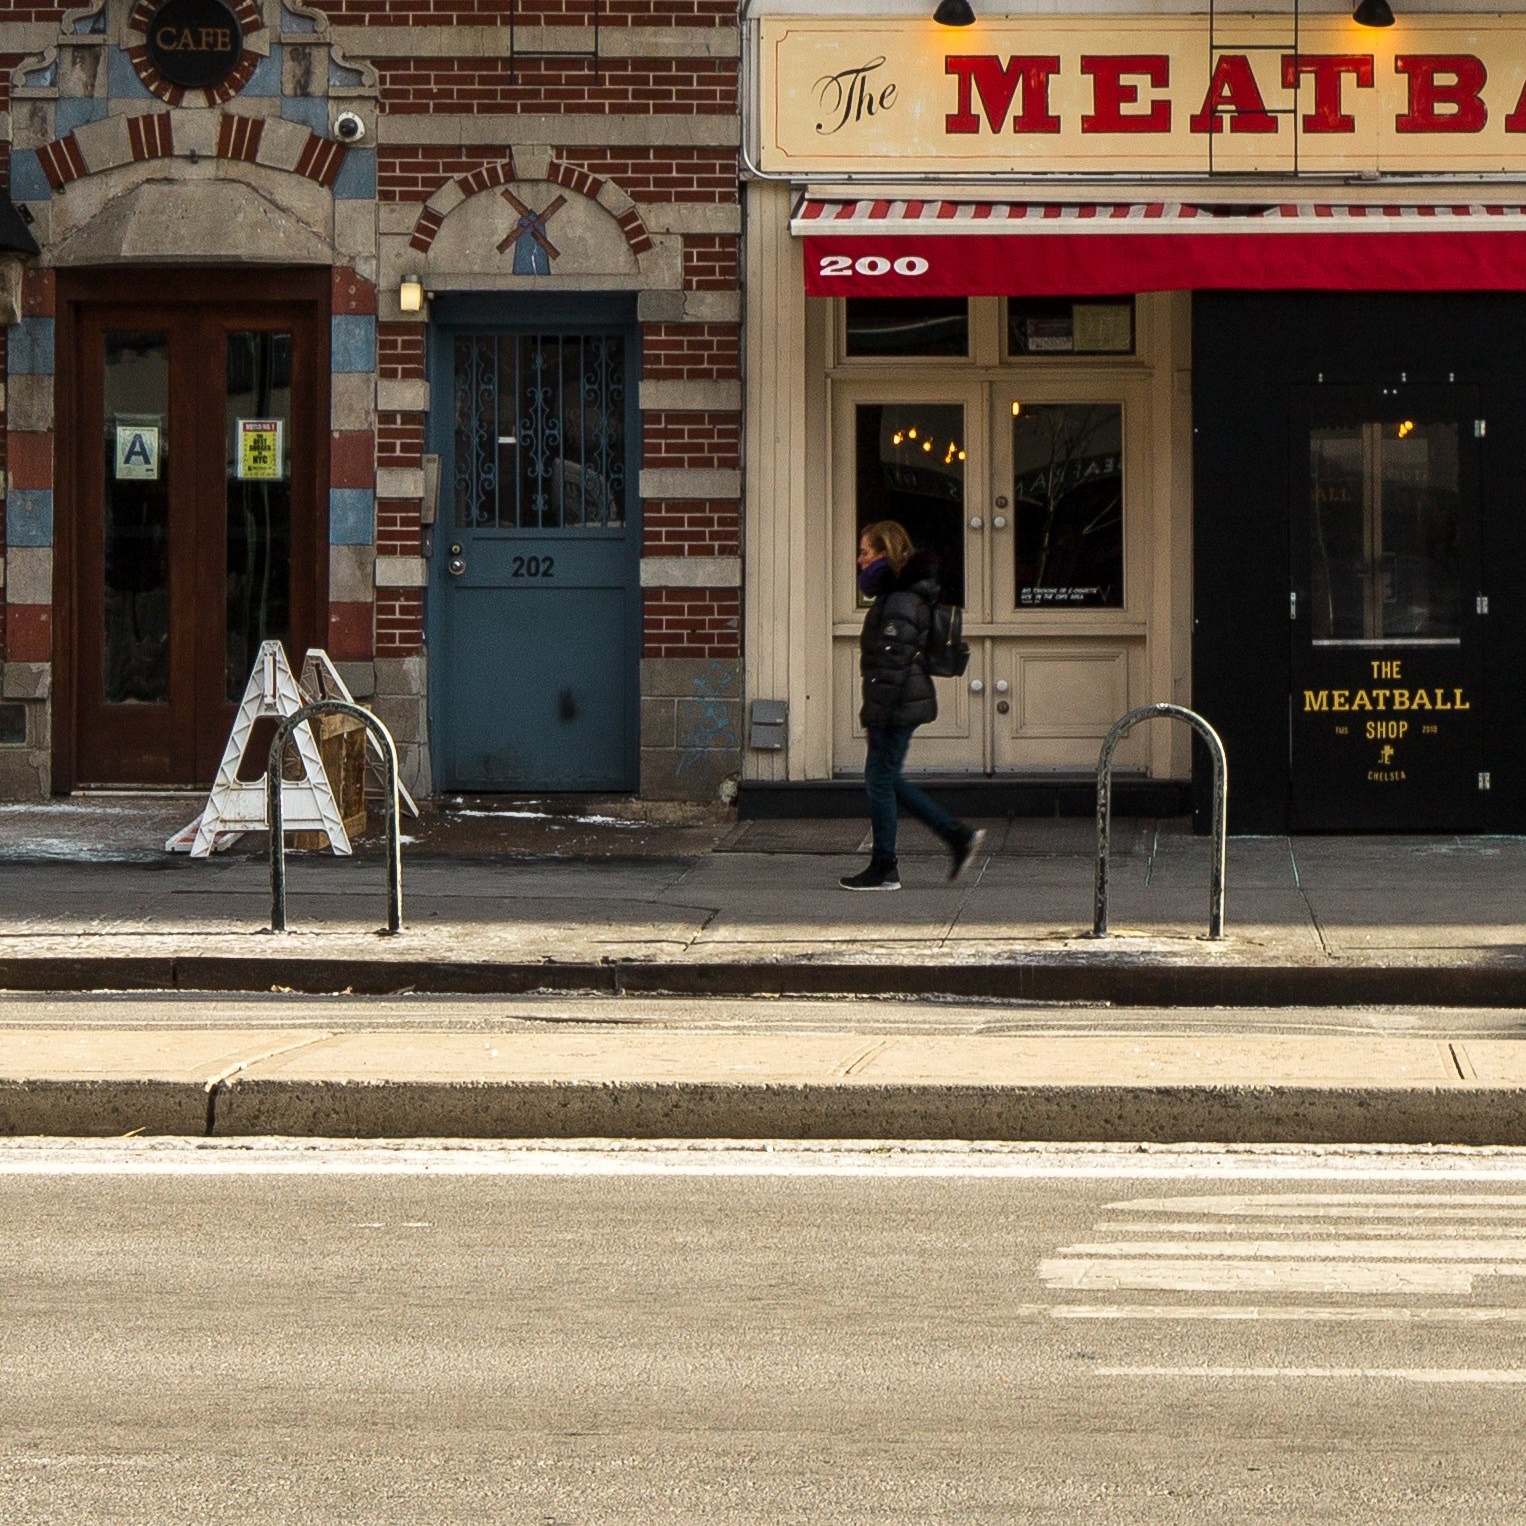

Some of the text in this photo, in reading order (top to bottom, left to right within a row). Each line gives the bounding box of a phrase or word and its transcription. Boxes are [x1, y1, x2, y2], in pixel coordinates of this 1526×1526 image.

[156, 27, 231, 53] CAFE
[811, 55, 898, 136] The
[819, 256, 929, 277] 200
[123, 433, 152, 465] A
[511, 556, 555, 578] 202
[1371, 660, 1402, 679] THE
[1303, 688, 1470, 712] MEATBALL
[1366, 721, 1408, 739] SHOP
[1367, 770, 1406, 782] CHELSEA
